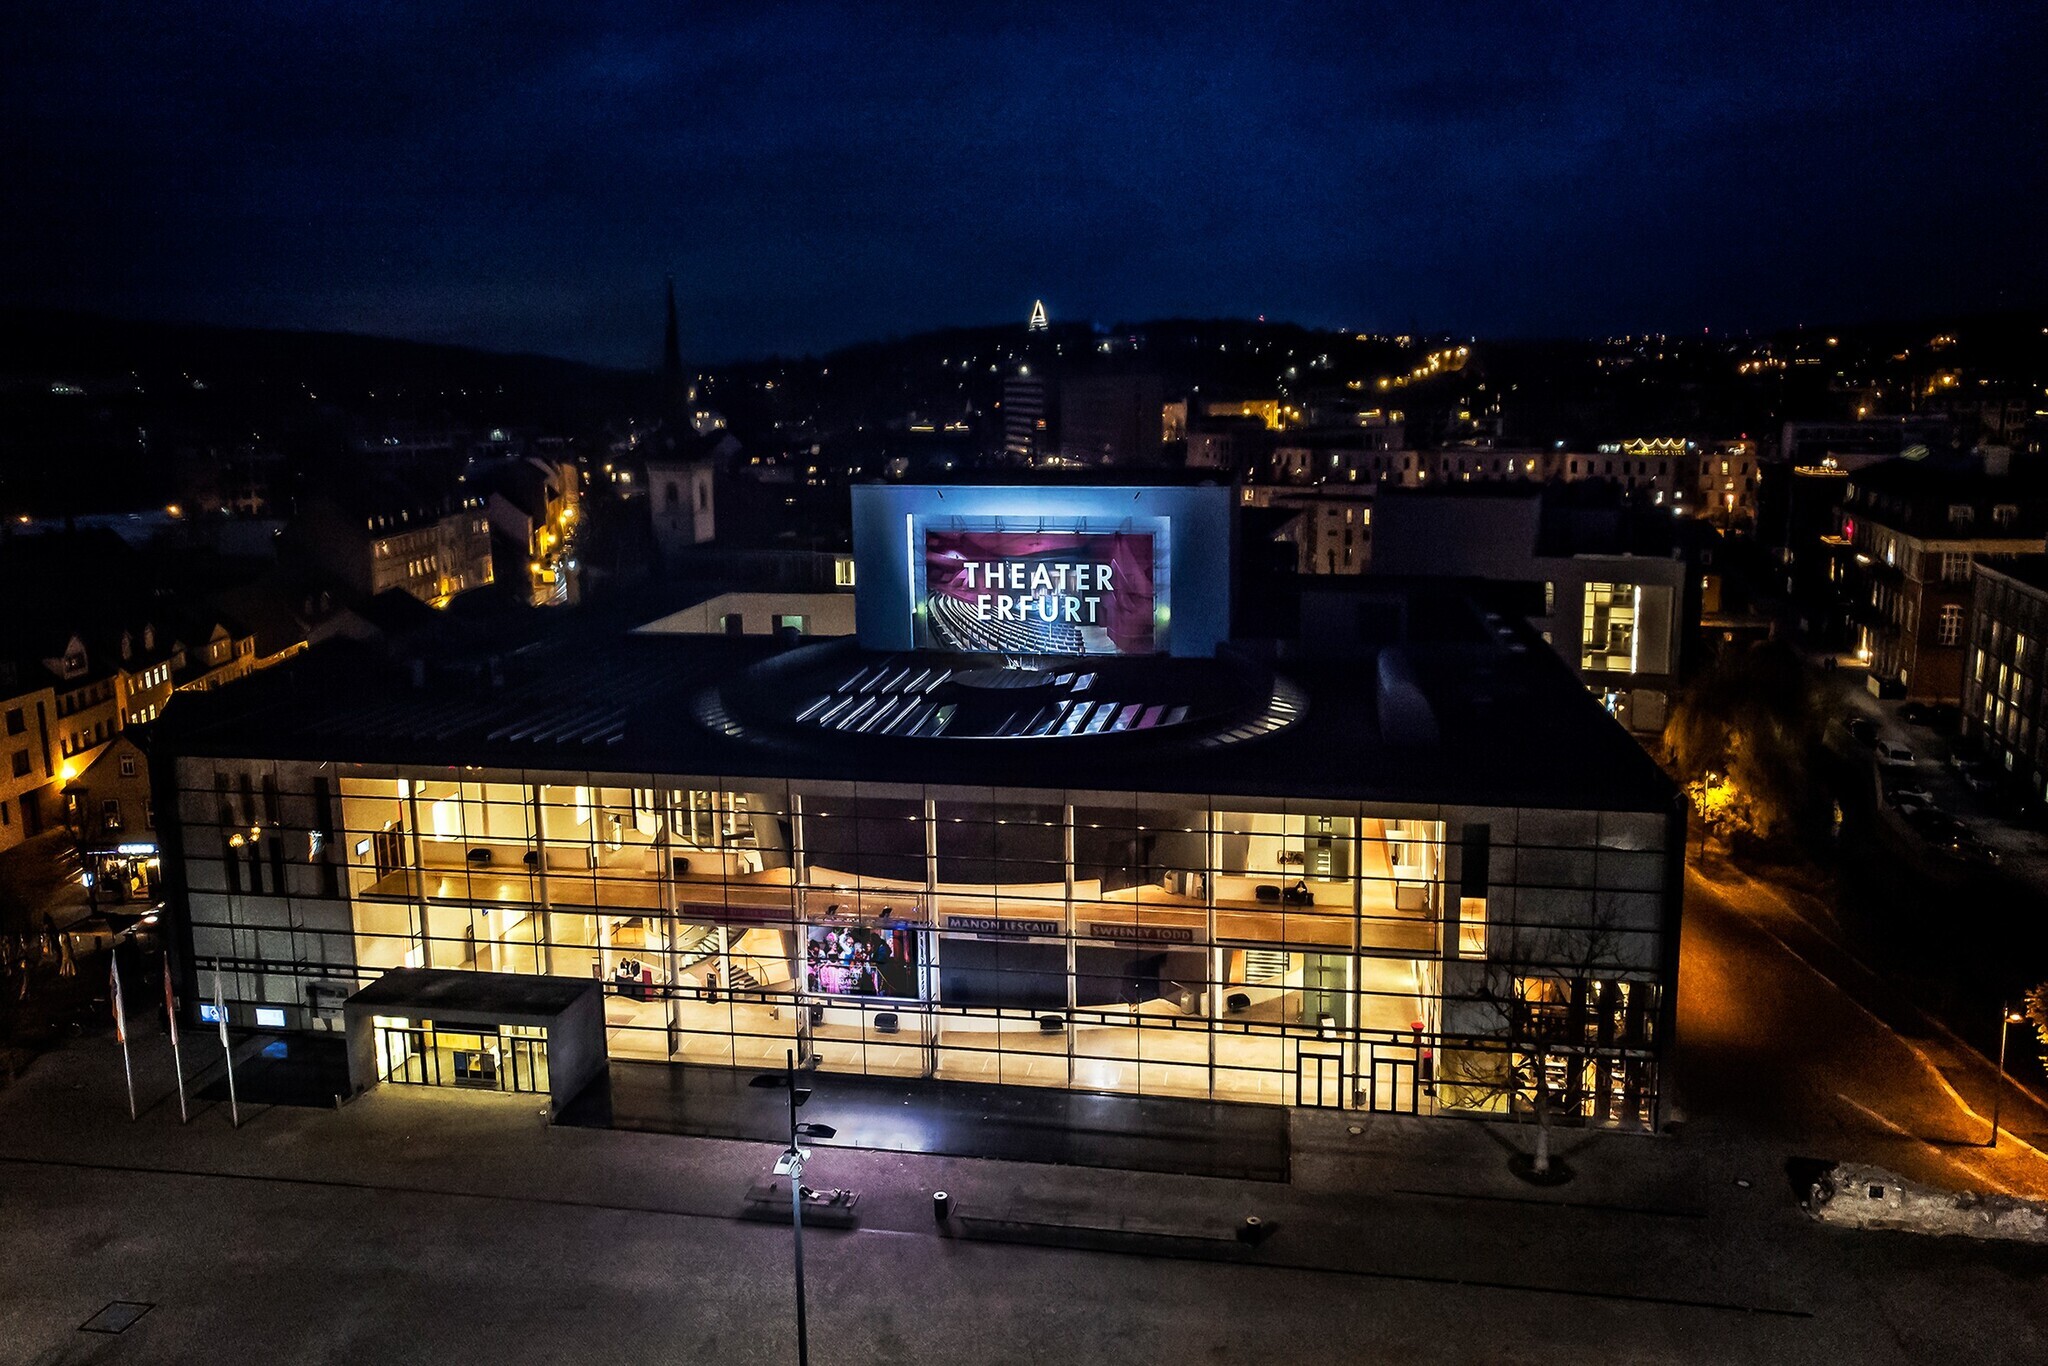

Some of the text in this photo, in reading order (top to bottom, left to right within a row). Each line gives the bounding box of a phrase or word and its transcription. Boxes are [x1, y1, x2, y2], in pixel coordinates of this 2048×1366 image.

[963, 562, 1114, 591] THEATER
[977, 594, 1101, 623] ERFURT
[949, 918, 1056, 933] MANON LESCAUT
[1092, 925, 1191, 940] SWEENEY TODD
